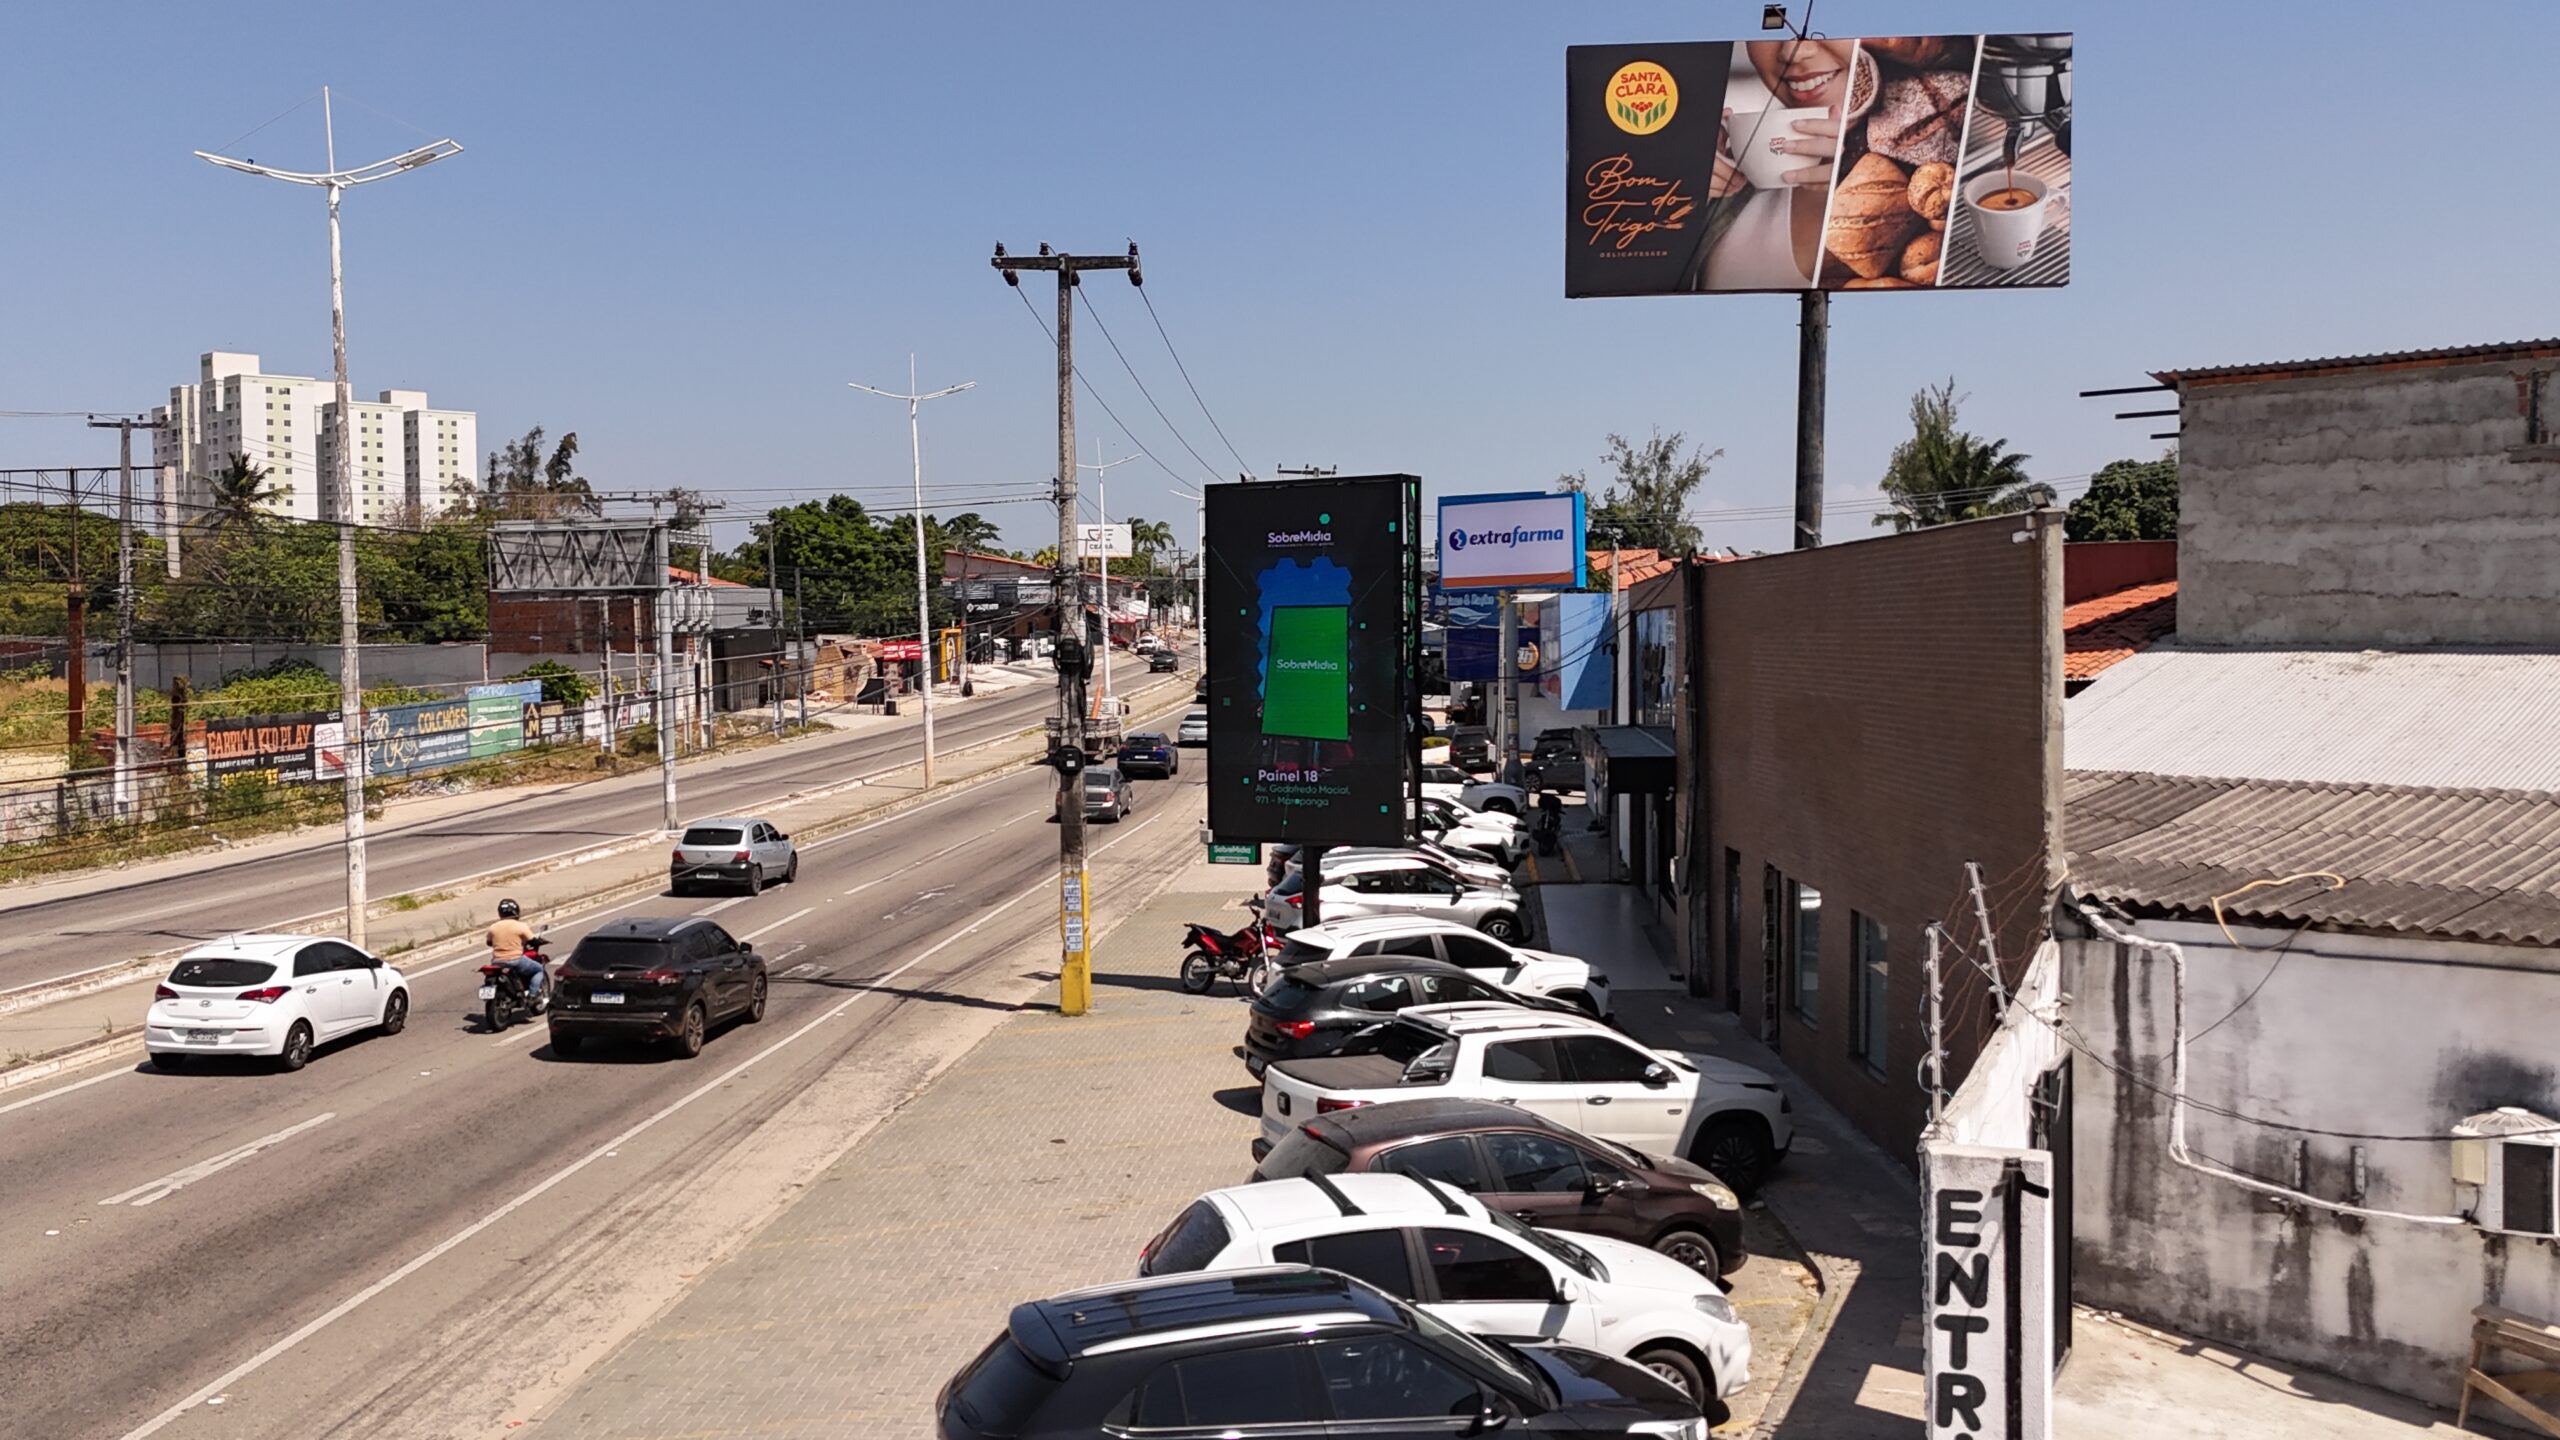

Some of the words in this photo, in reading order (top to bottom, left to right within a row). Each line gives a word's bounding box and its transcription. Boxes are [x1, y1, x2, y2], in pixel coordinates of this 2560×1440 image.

[1616, 83, 1667, 98] CLARA
[1620, 72, 1662, 84] SANTA
[1585, 153, 1669, 200] Bom
[1651, 180, 1692, 216] do
[1583, 200, 1656, 249] Trigo
[1469, 525, 1564, 548] extrafarma
[418, 706, 468, 734] COLCHÕES
[1258, 769, 1300, 782] Painel
[1303, 770, 1319, 783] 18
[1934, 1188, 1990, 1440] ENTR
